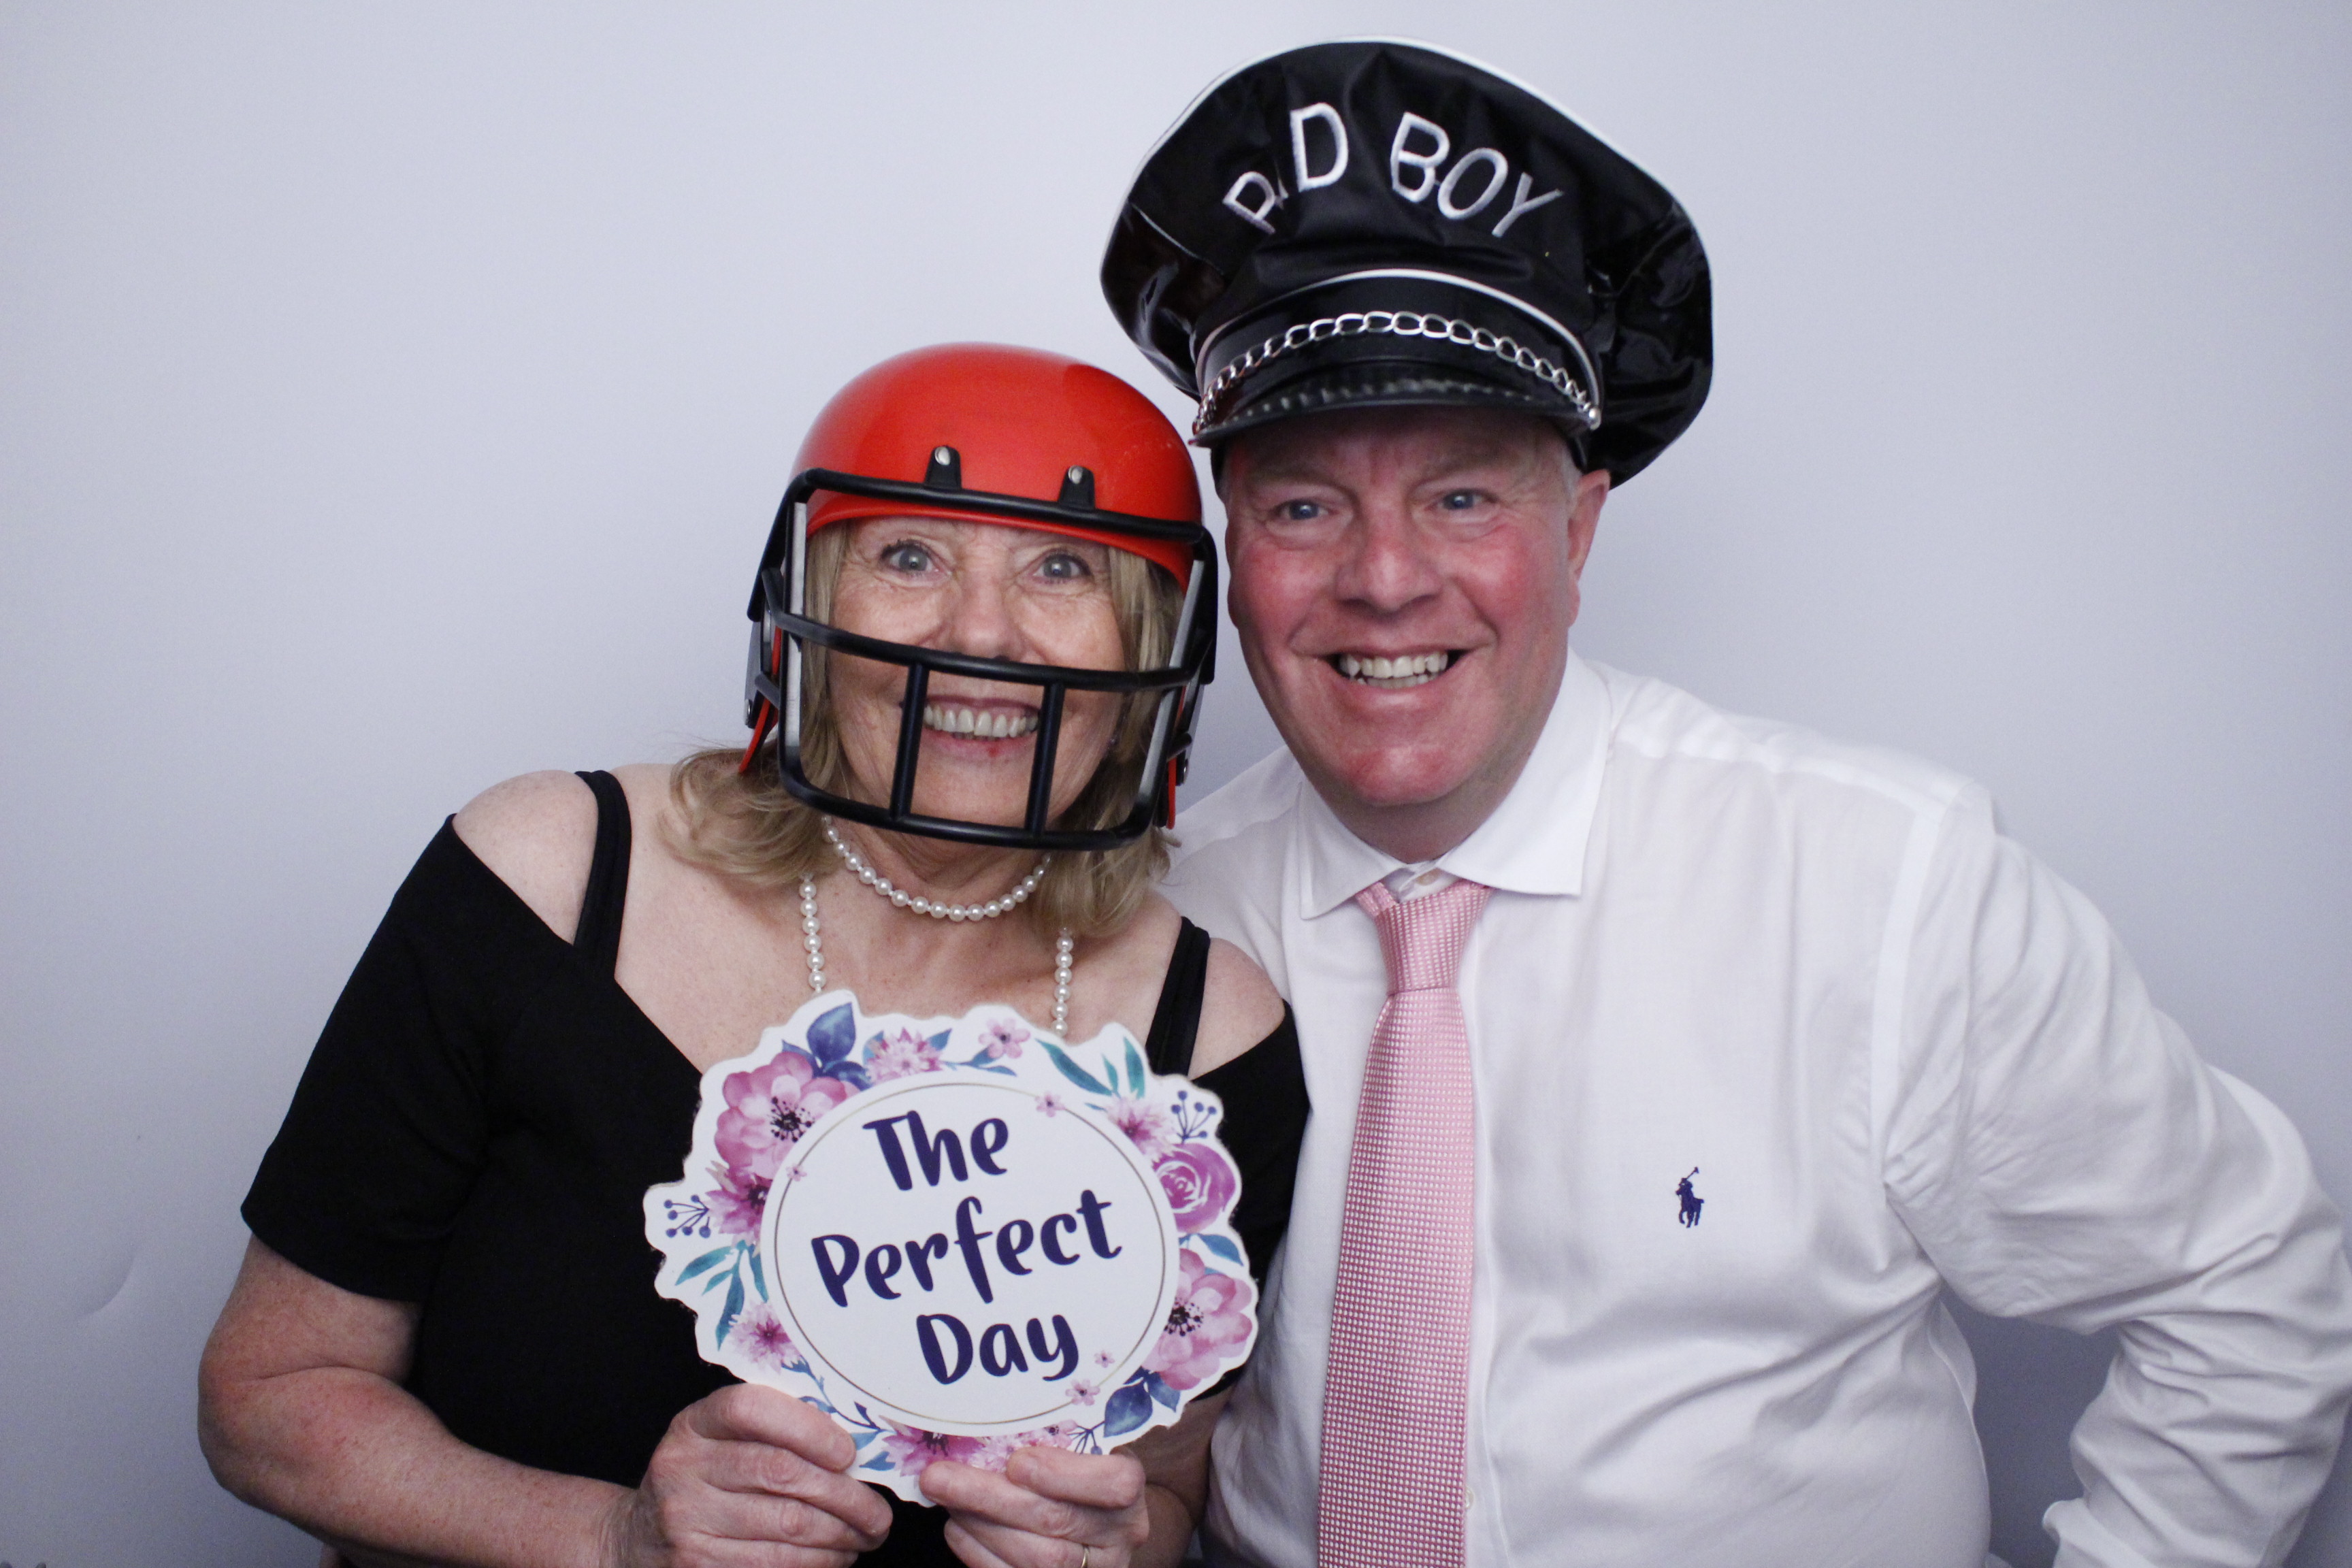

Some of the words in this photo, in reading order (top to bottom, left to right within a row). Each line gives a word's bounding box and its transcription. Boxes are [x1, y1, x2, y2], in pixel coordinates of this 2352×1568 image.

[1390, 112, 1564, 237] BOY
[862, 1110, 1009, 1191] The
[811, 1189, 1122, 1307] Perfect
[916, 1313, 1079, 1385] Day
